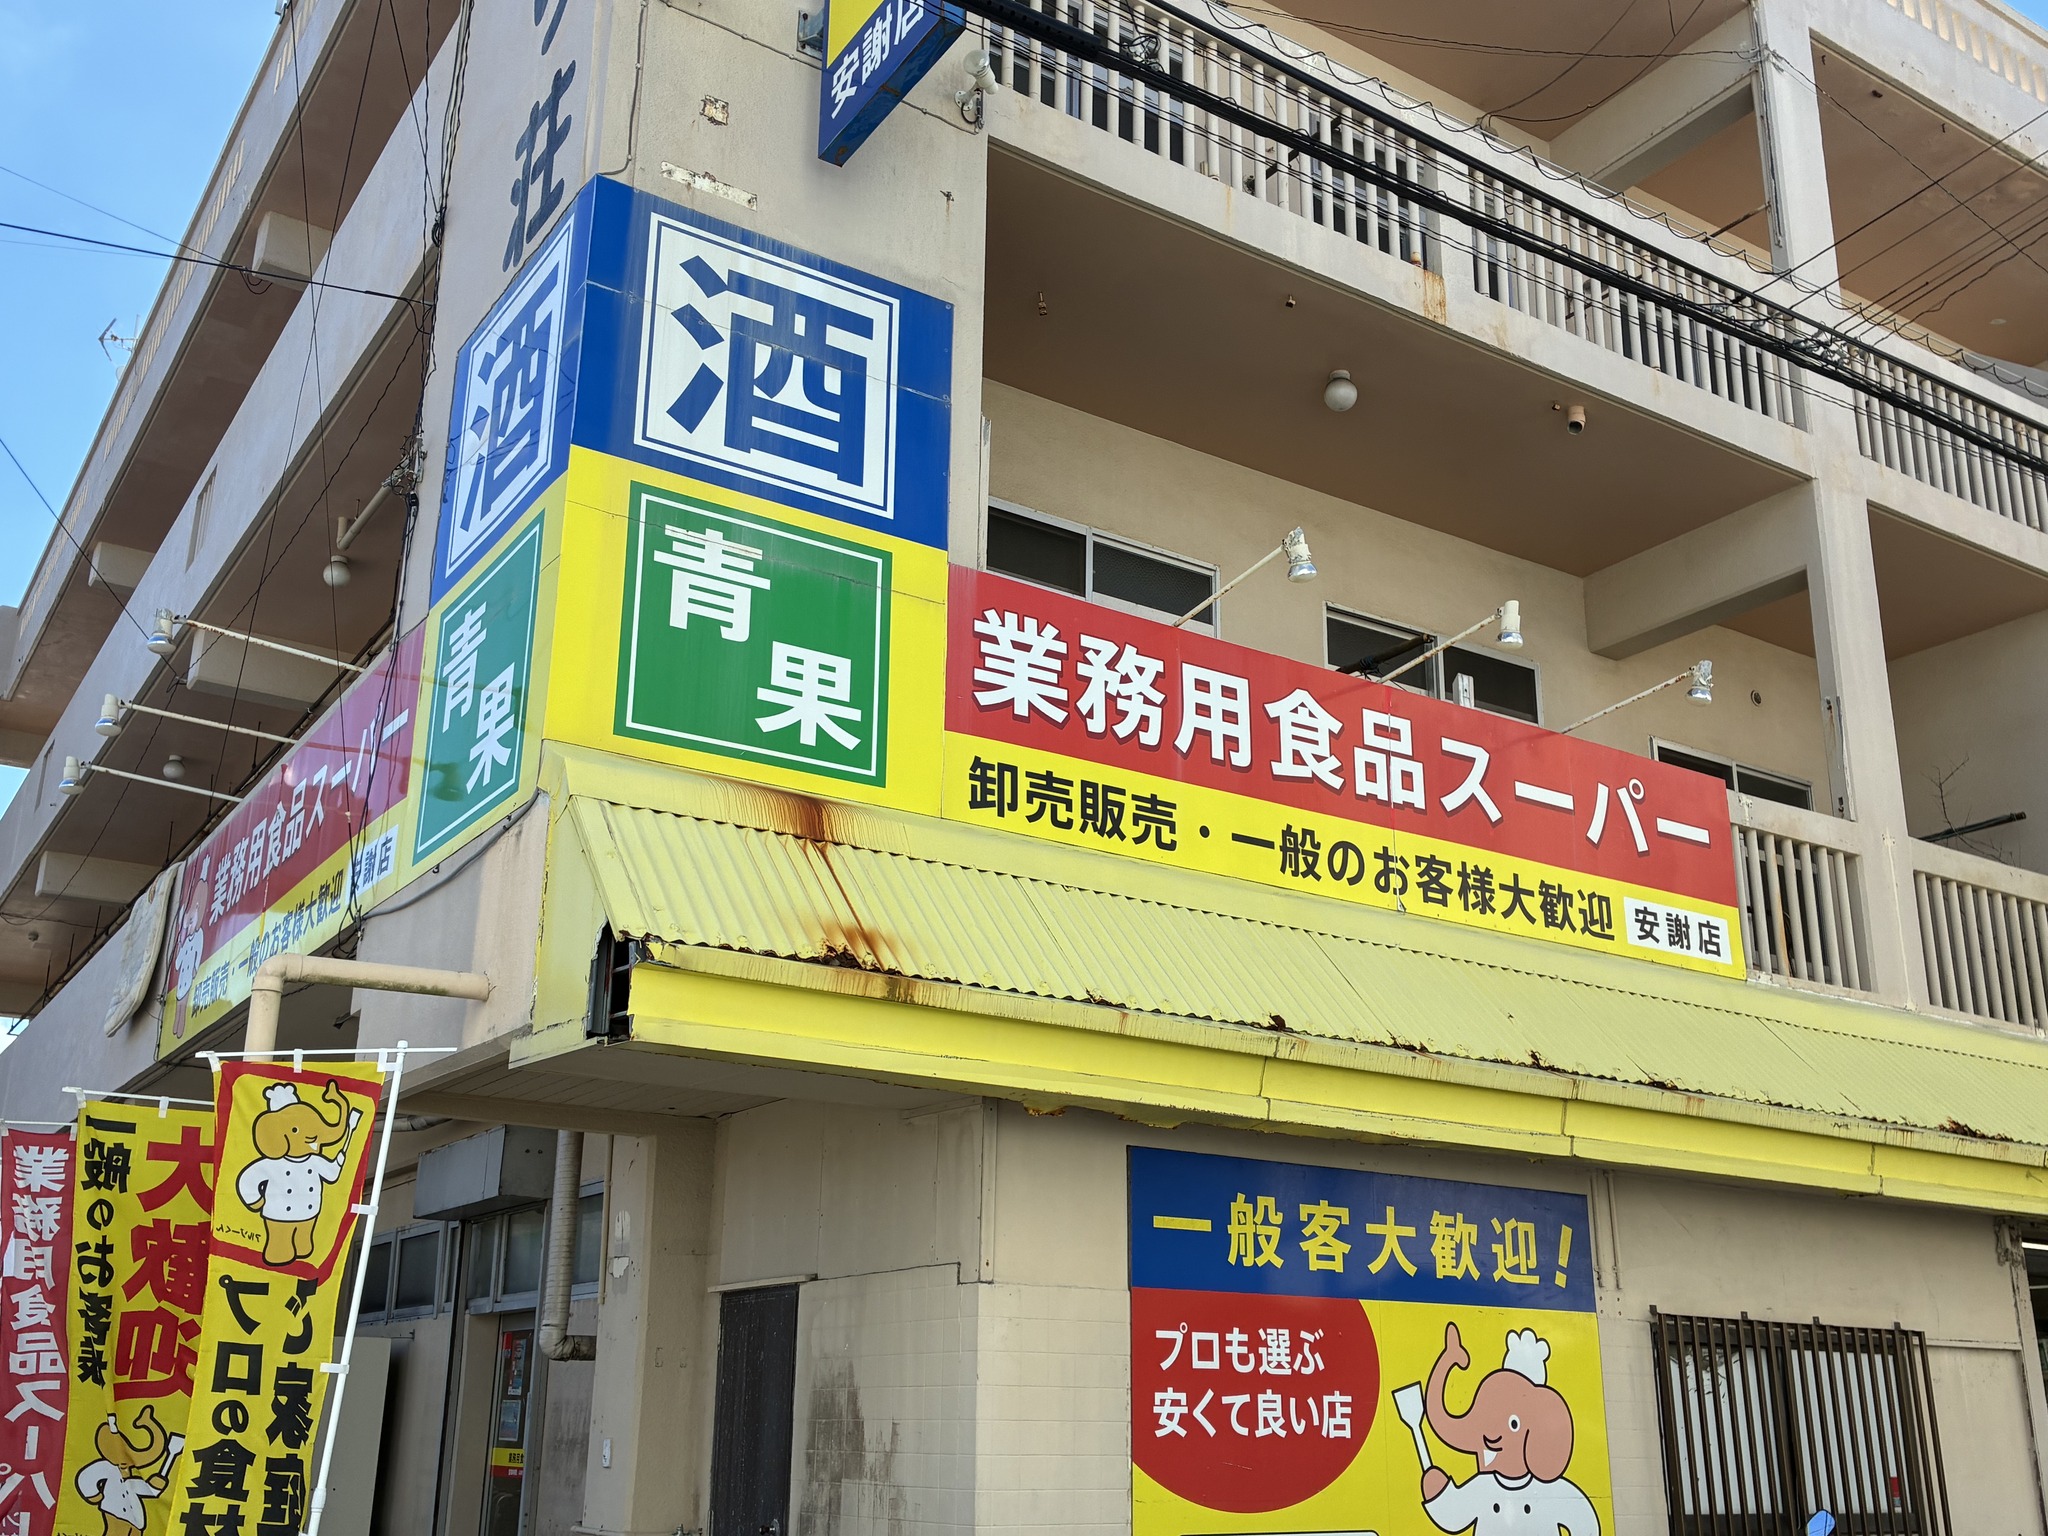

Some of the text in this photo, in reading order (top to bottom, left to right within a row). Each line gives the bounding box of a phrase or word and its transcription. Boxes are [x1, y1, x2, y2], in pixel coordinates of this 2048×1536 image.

[460, 269, 561, 532] 酒
[666, 255, 875, 488] 酒
[208, 701, 409, 926] 業務用食品スーパー
[972, 608, 1711, 853] 業務用食品スーパー
[1634, 906, 1722, 957] 安謝店
[1153, 1387, 1352, 1439] 安くて良い店
[1155, 1321, 1324, 1376] プロも選ぶ
